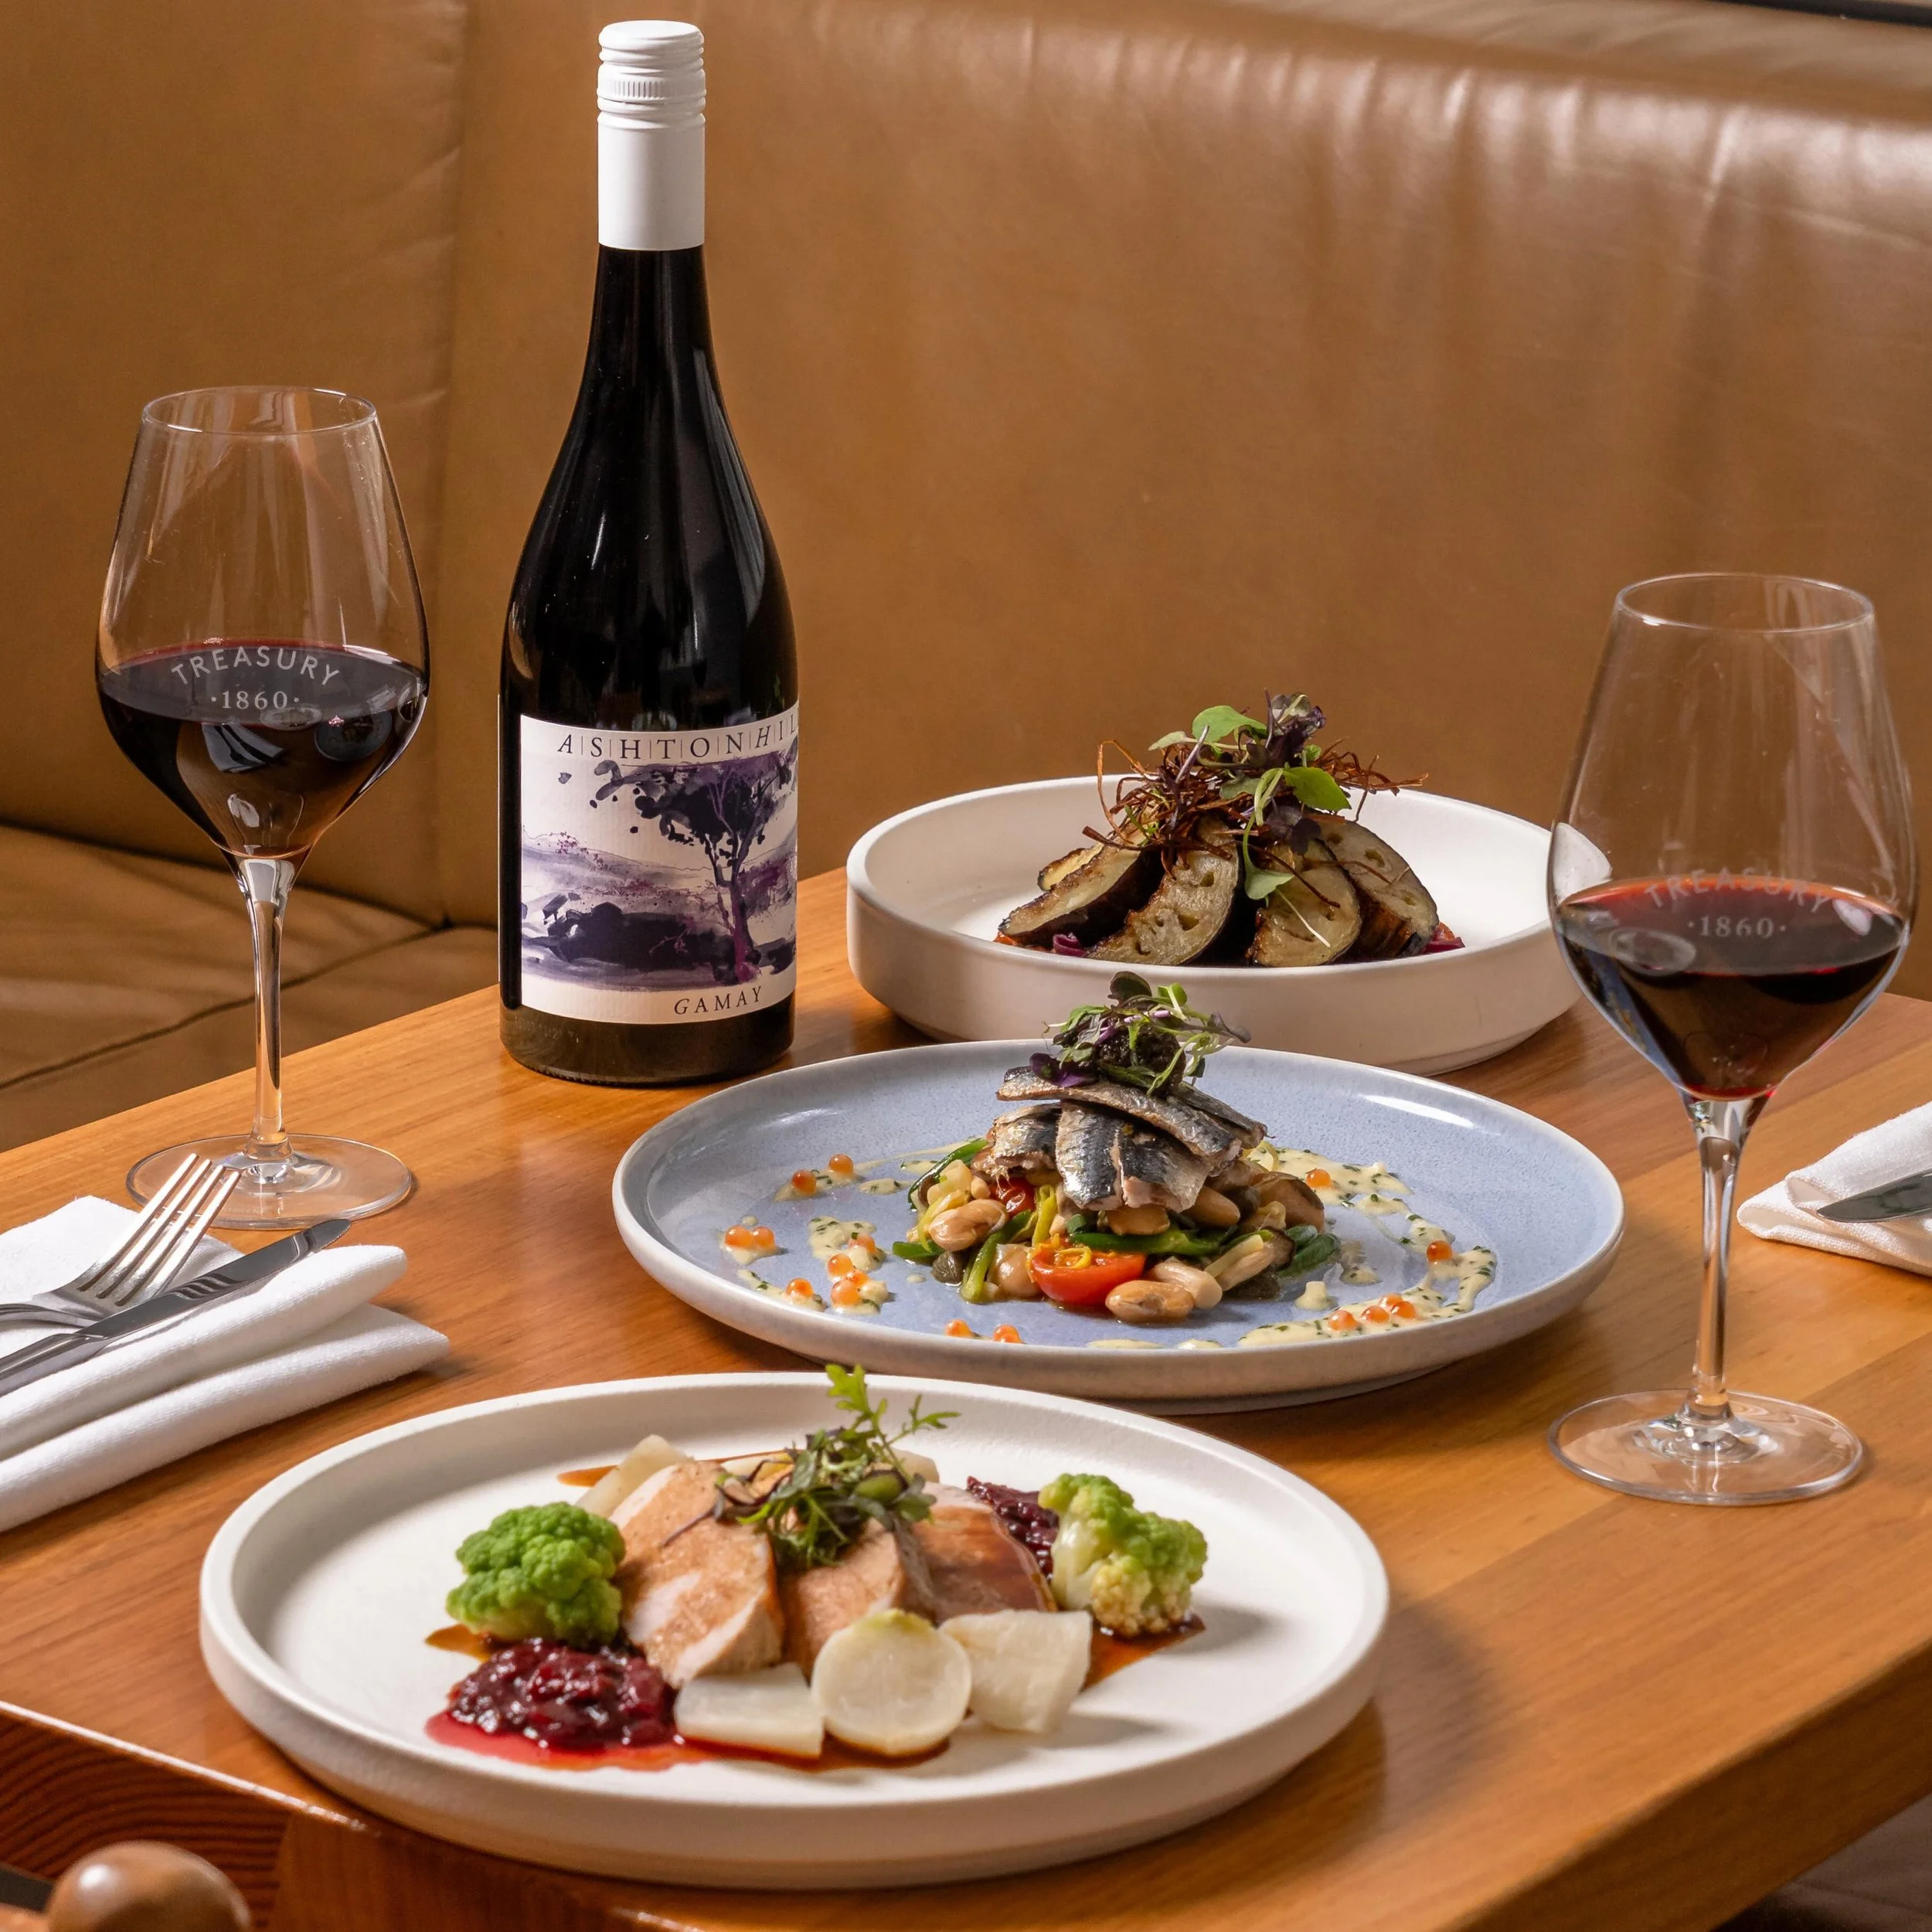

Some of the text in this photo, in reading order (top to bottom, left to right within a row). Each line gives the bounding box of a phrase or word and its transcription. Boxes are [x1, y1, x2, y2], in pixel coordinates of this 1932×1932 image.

[171, 646, 340, 685] TREASURY
[1644, 866, 1831, 914] TREASURY
[674, 985, 763, 1015] GAMAY
